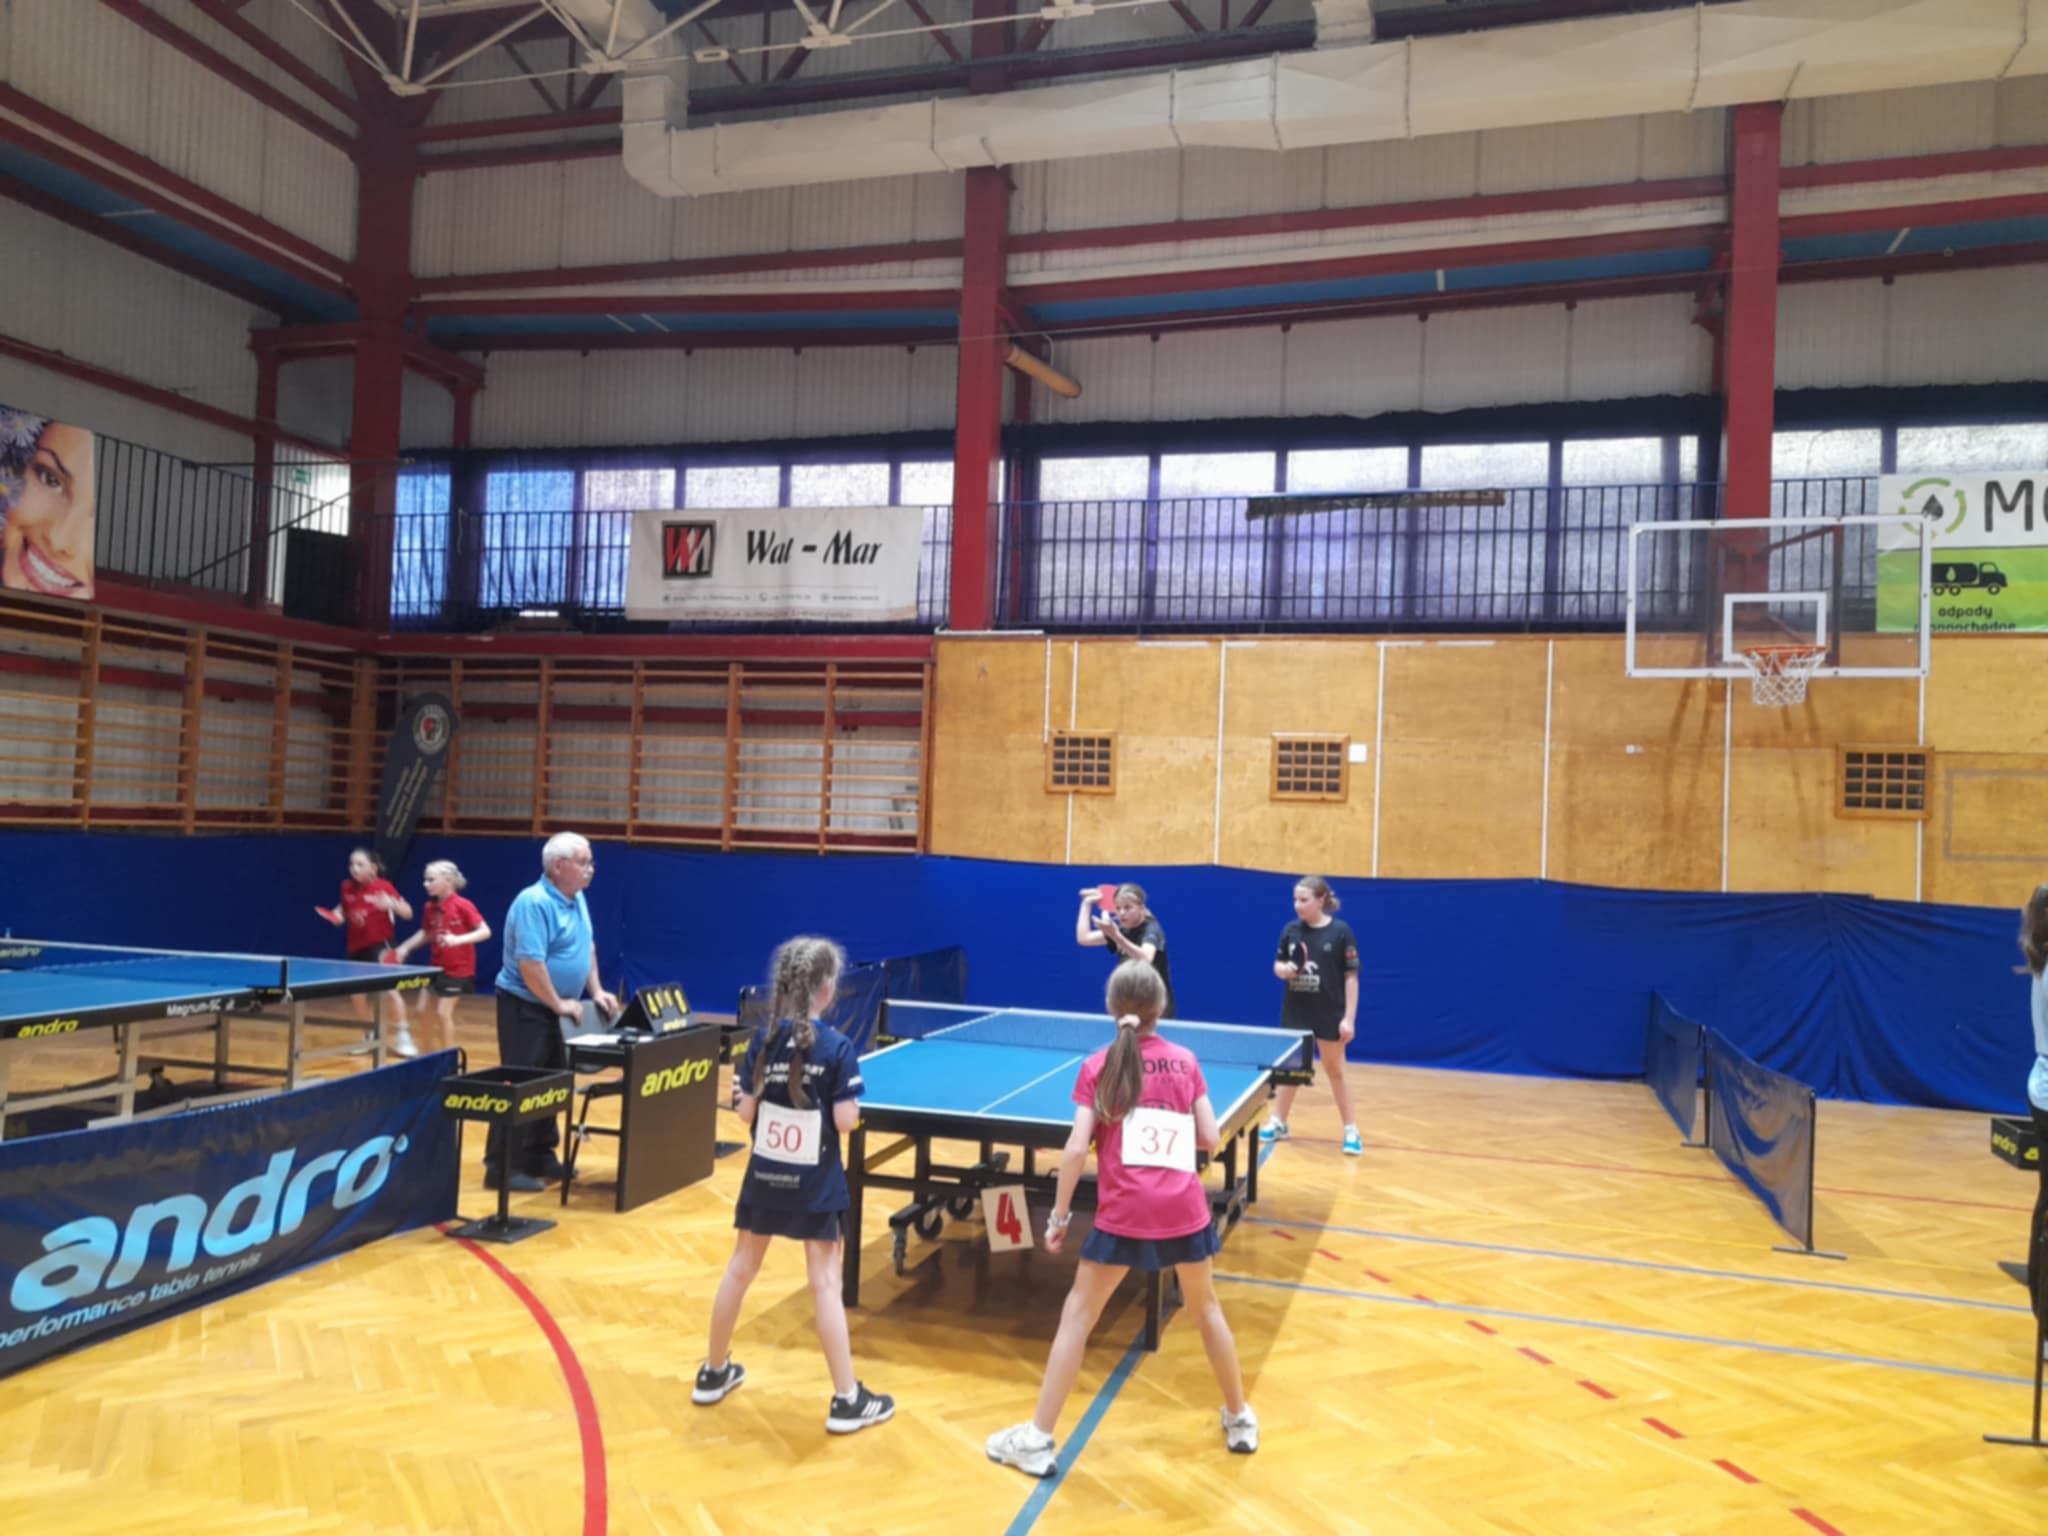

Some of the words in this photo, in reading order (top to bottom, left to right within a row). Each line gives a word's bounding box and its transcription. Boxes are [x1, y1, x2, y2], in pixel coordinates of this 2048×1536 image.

[1984, 479, 2048, 533] M
[823, 529, 882, 565] Mar
[17, 1018, 79, 1039] andro
[641, 1058, 714, 1097] andro
[1143, 1058, 1188, 1075] ORCE
[445, 1093, 511, 1113] andro
[519, 1087, 570, 1114] andro
[766, 1120, 803, 1153] 50
[1140, 1125, 1179, 1156] 37
[10, 1135, 396, 1312] andro
[996, 1192, 1022, 1245] 4
[149, 1273, 200, 1302] table
[202, 1250, 262, 1285] tennis
